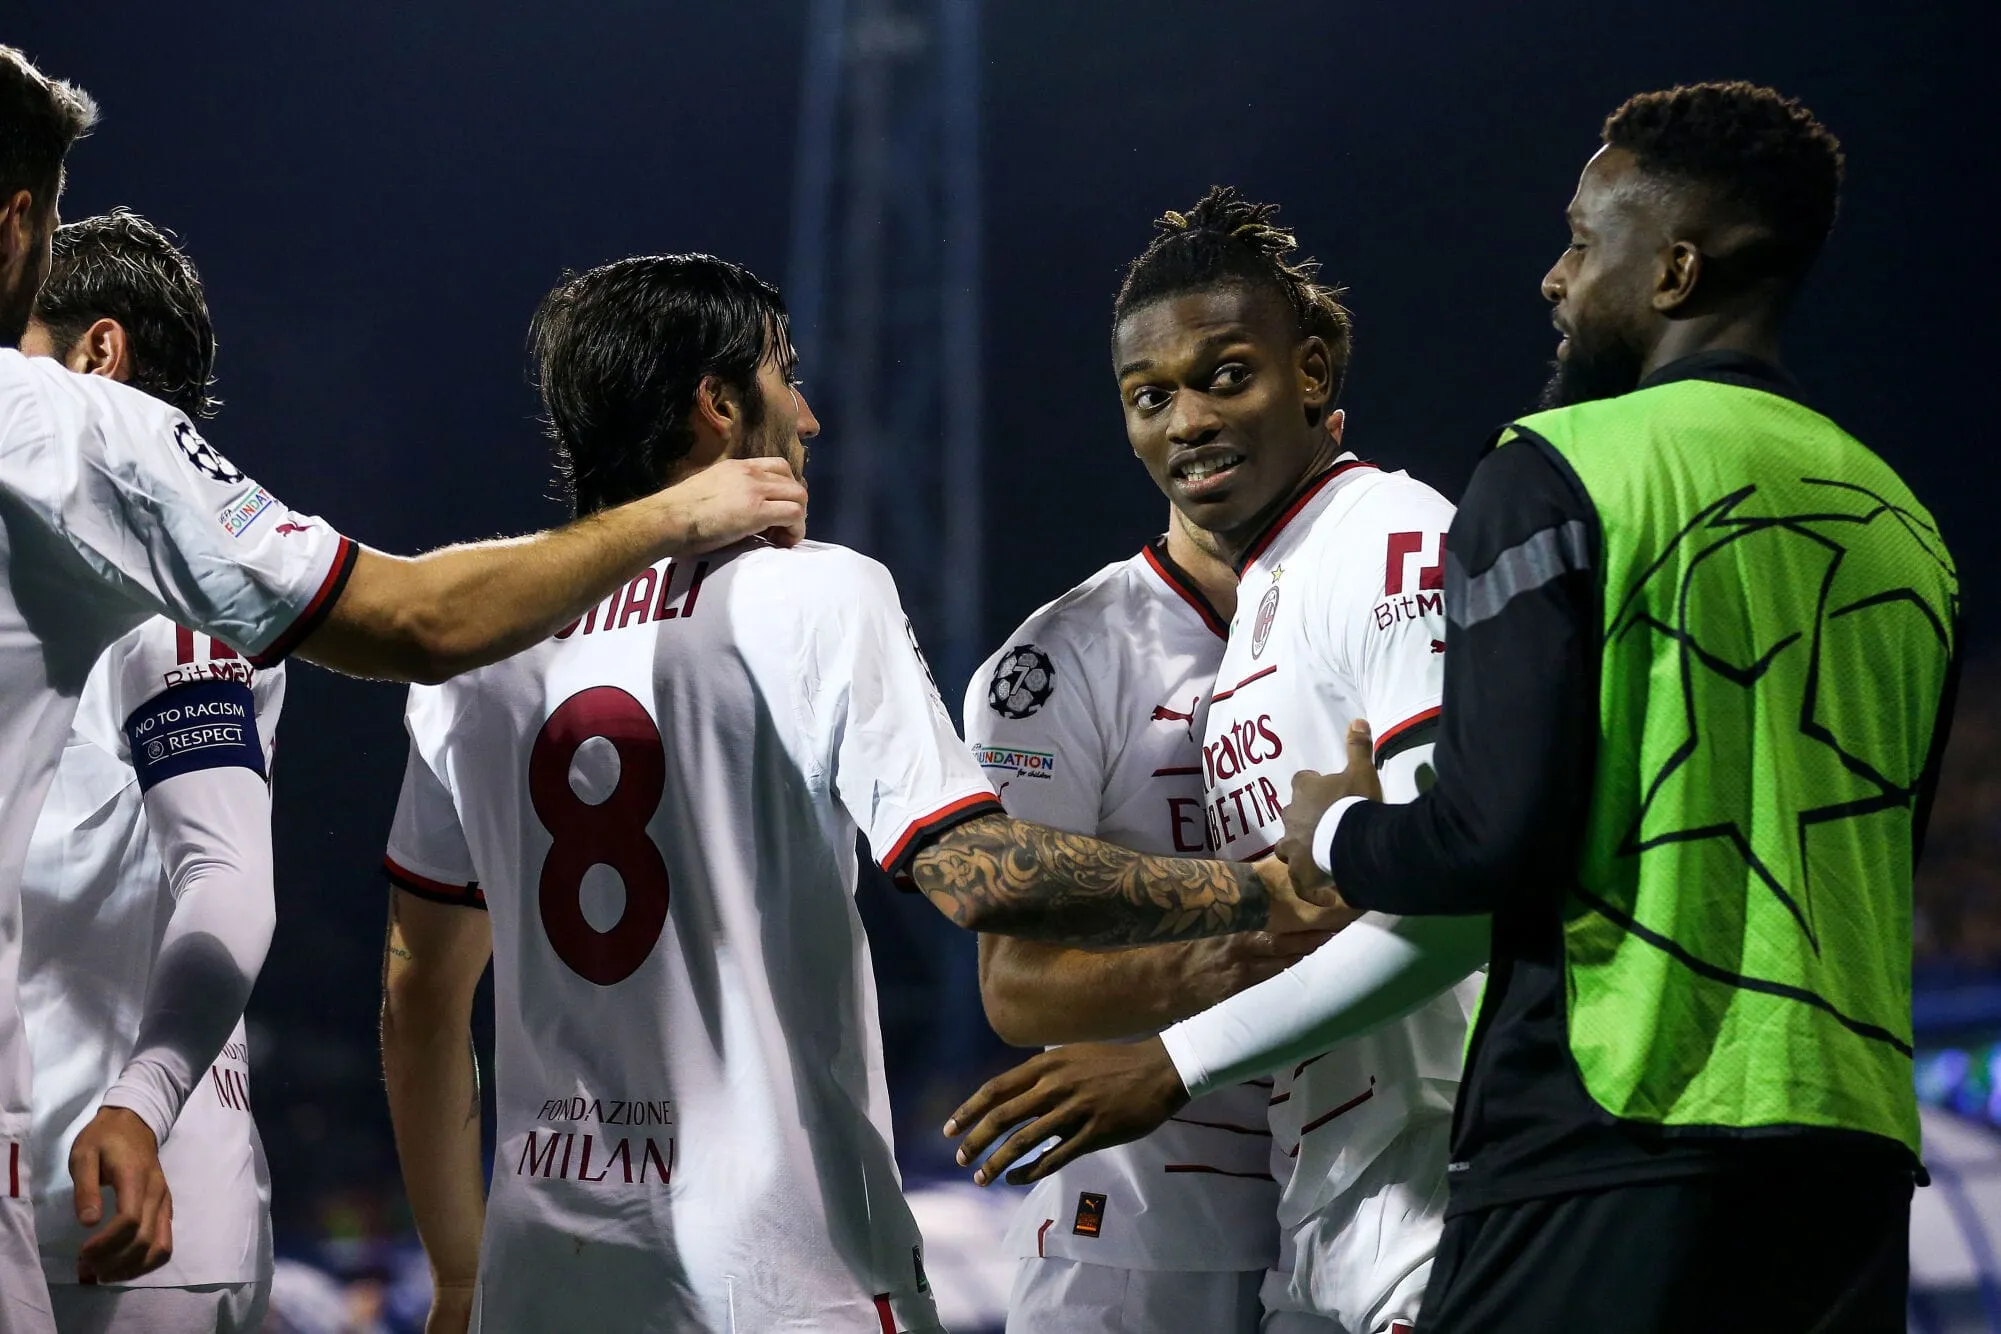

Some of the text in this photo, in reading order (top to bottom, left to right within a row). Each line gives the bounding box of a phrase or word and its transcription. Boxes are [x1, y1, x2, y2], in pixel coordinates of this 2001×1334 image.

[553, 560, 710, 640] ALI
[1012, 665, 1030, 696] 7
[135, 702, 245, 738] NO TO RACISM
[169, 728, 242, 751] RESPECT
[1201, 714, 1283, 794] rates
[974, 751, 1054, 771] UNDATION
[1017, 768, 1051, 780] for children
[1208, 776, 1284, 852] BETTR
[529, 685, 670, 986] 8
[537, 1096, 673, 1126] FONDAZIONE
[517, 1130, 674, 1185] MILAN
